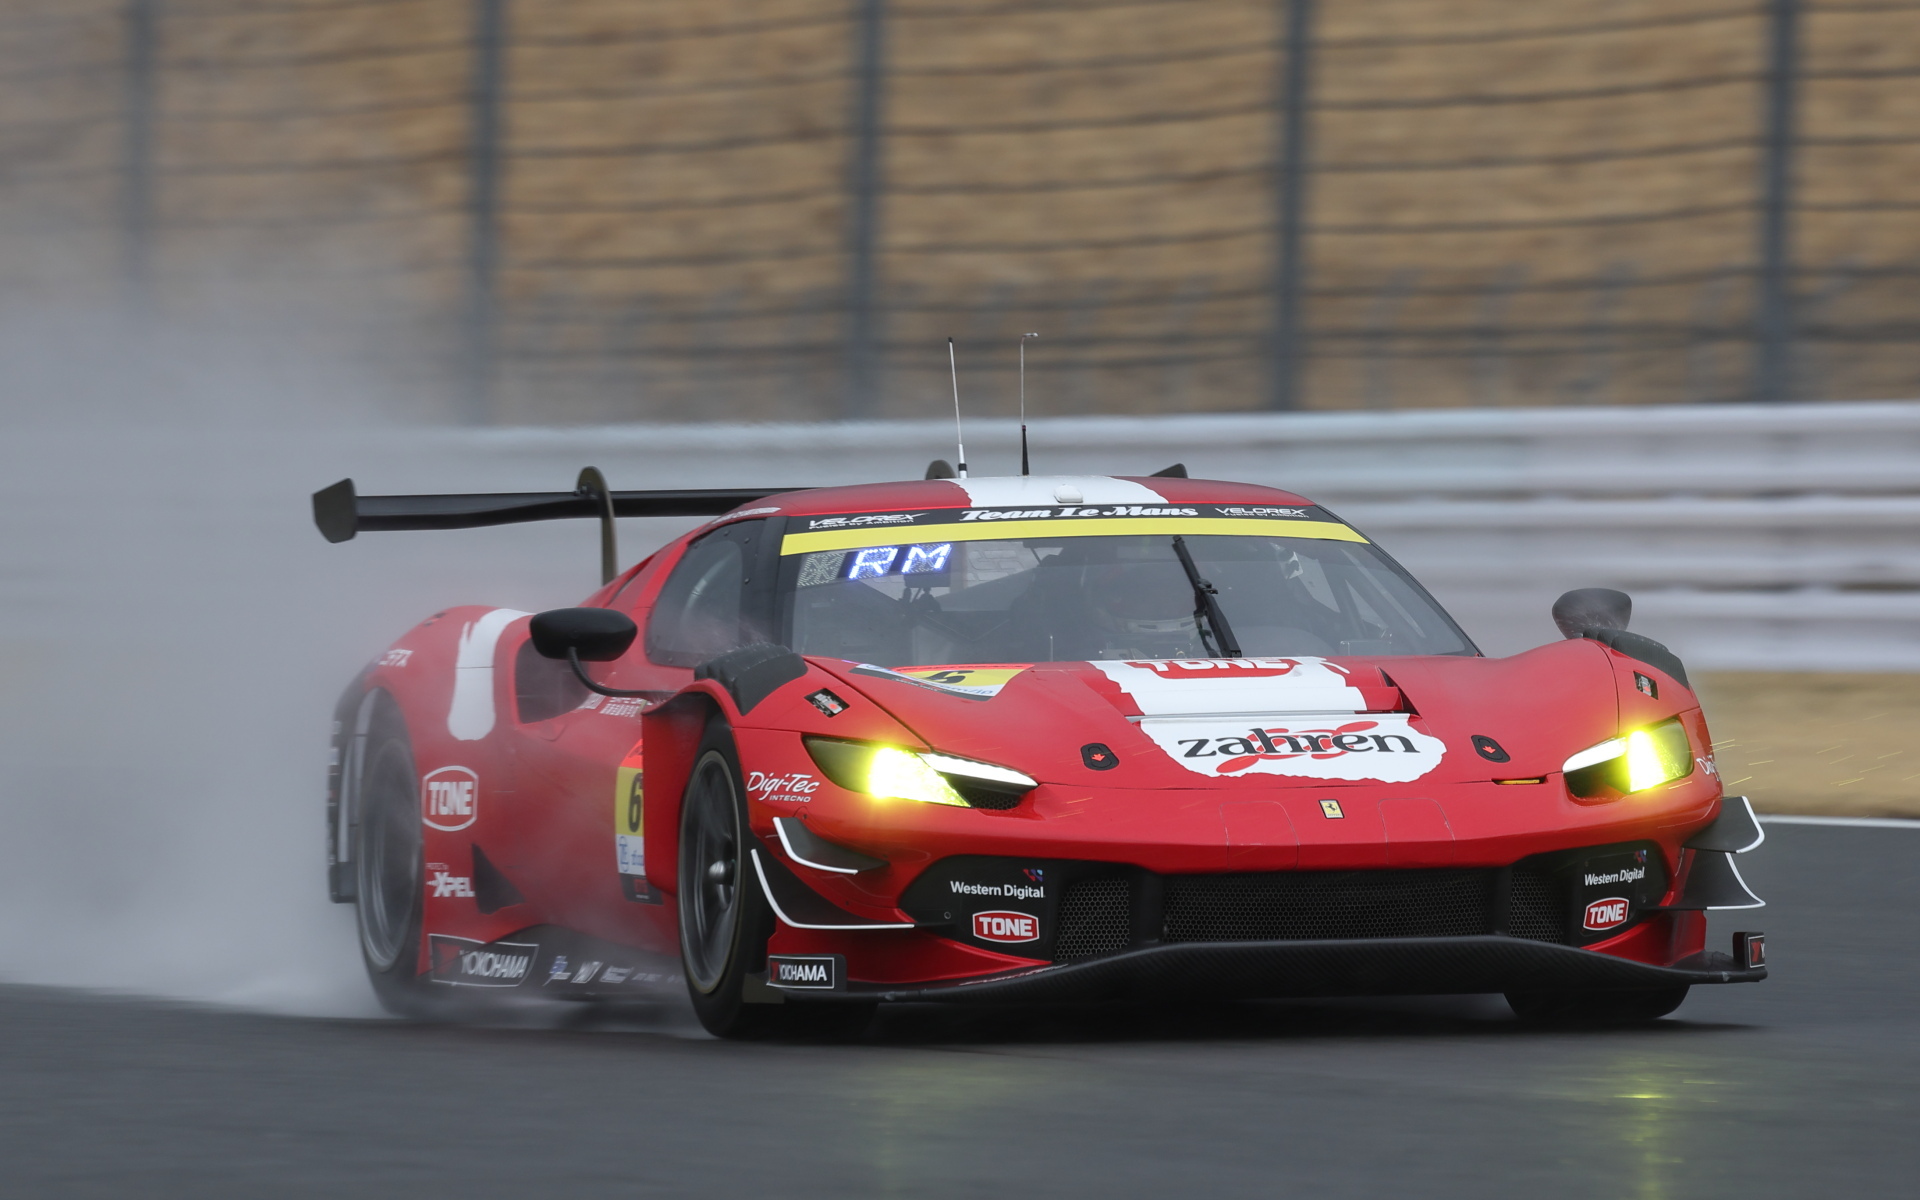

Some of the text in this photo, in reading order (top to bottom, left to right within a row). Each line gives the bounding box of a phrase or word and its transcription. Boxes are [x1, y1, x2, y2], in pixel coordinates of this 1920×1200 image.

[809, 512, 930, 528] VELOREX
[959, 505, 1199, 521] Team Le Mans
[1215, 507, 1308, 516] VELOREX
[1136, 658, 1291, 672] TONE
[1177, 728, 1421, 758] zahren
[746, 771, 820, 801] Digi-Tec
[428, 781, 474, 815] TONE
[628, 772, 644, 833] 6
[769, 794, 811, 803] INTECNO
[432, 871, 476, 898] XPEL
[1584, 866, 1645, 887] Western Digital
[950, 880, 1044, 900] Western Digital
[1589, 902, 1626, 925] TONE
[978, 916, 1034, 937] TONE
[459, 950, 530, 979] YOKOHAMA
[779, 963, 828, 982] YOKOHAMA
